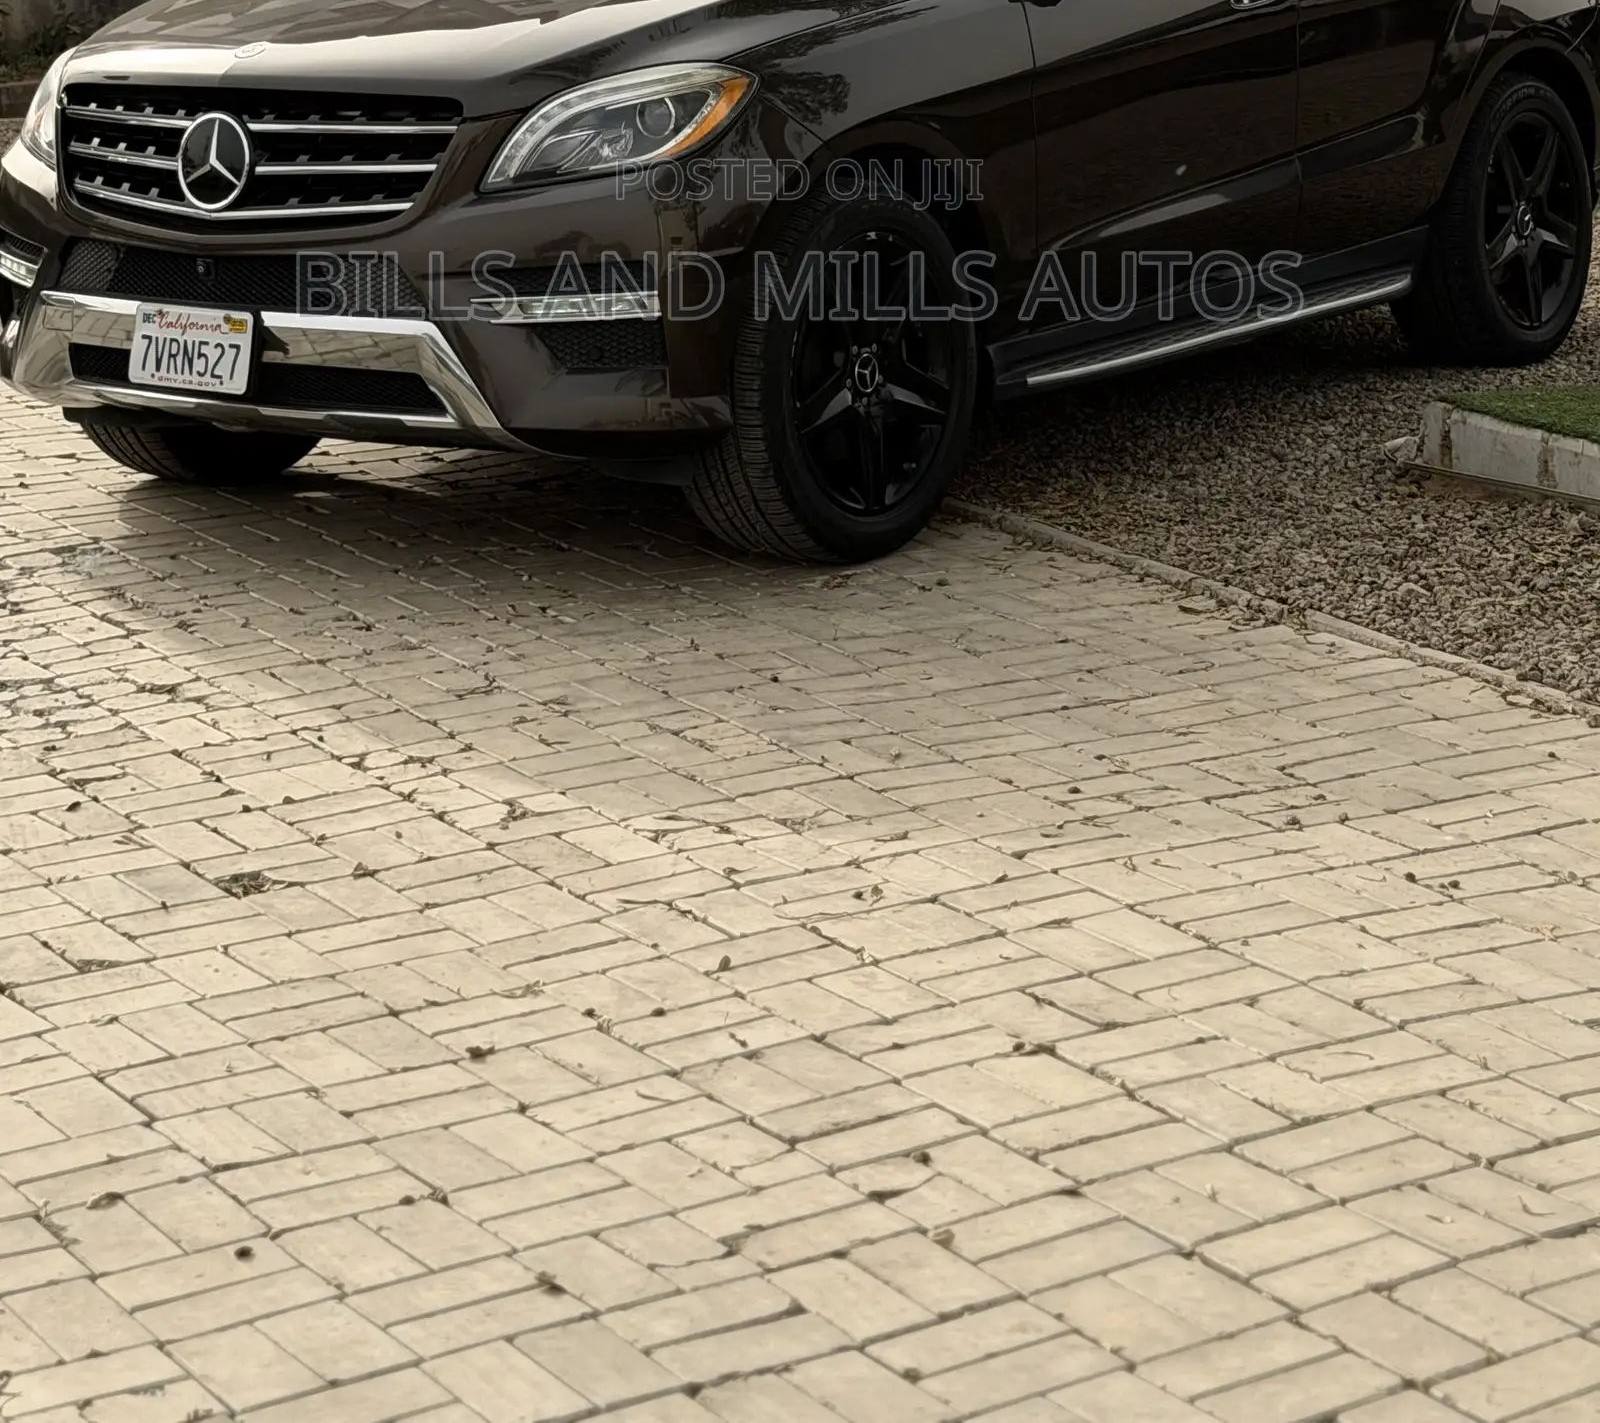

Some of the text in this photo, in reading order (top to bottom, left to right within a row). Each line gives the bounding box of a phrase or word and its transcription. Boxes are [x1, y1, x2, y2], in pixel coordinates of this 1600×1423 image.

[142, 312, 157, 324] DEC
[158, 311, 228, 336] California
[140, 334, 241, 380] 7VRN527
[157, 375, 217, 387] dmv.ca.gov
